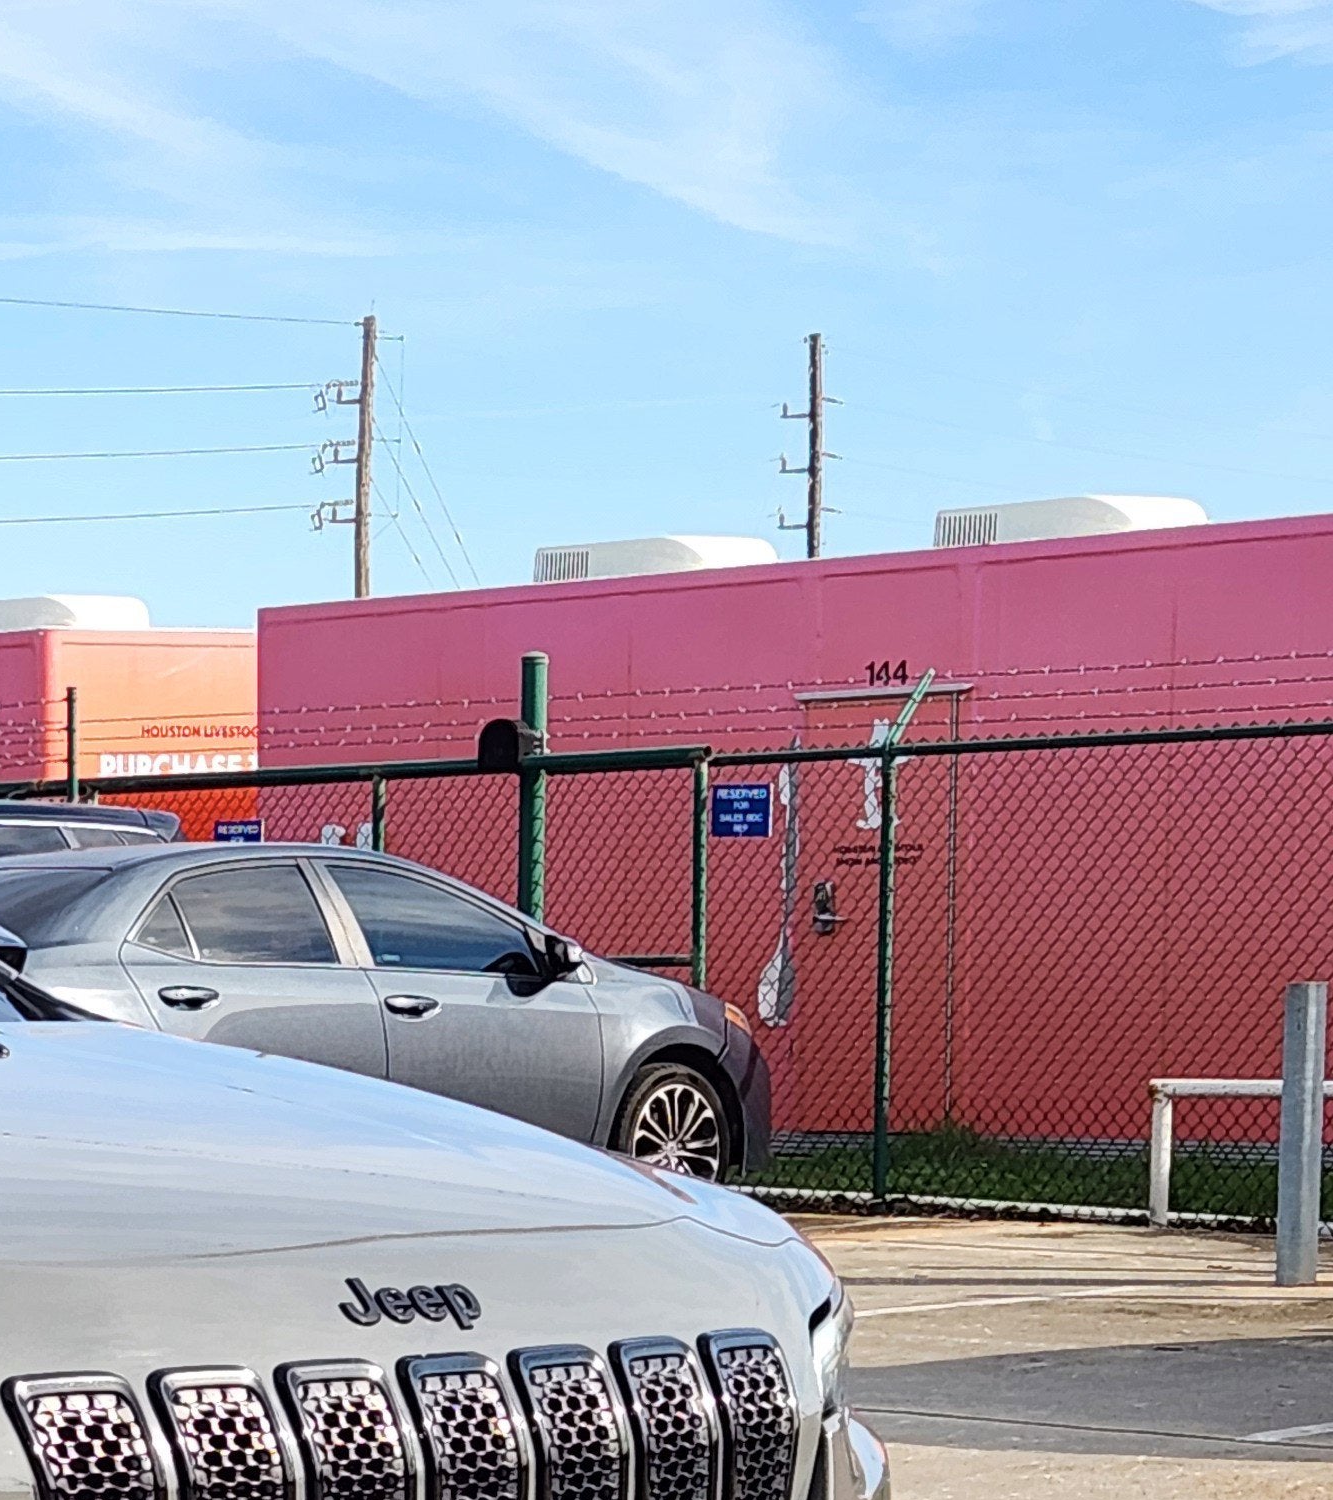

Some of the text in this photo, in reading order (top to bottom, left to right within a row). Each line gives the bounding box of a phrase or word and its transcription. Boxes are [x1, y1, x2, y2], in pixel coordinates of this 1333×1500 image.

[864, 659, 909, 687] 144
[140, 725, 201, 738] HOUSTON
[97, 753, 242, 778] PURCHASE
[716, 788, 767, 800] RESERVED
[338, 1277, 482, 1331] Jeep
